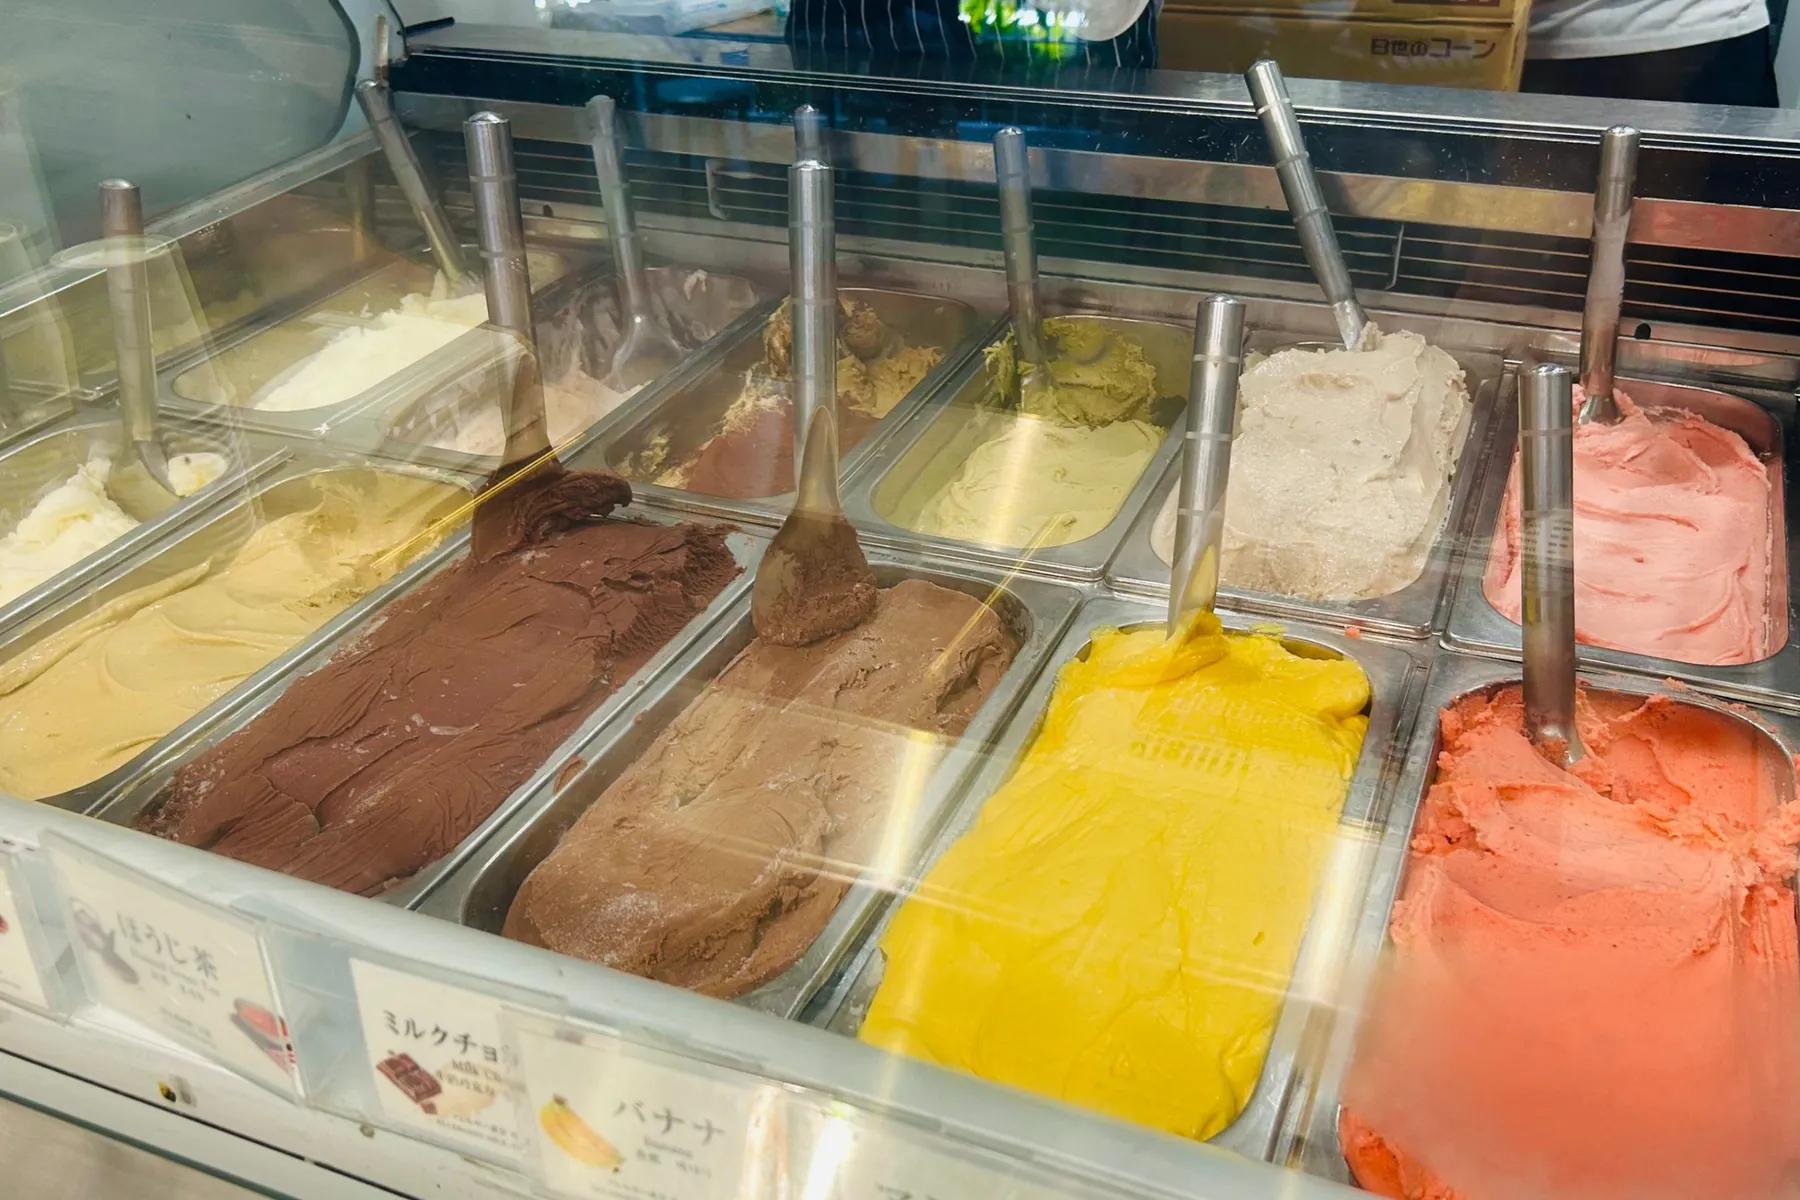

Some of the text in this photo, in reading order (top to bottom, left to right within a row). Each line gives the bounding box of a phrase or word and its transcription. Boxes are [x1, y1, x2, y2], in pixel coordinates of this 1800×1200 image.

[1371, 37, 1496, 58] 日世のコーン
[116, 911, 218, 981] ほうじ茶
[613, 1100, 725, 1146] バナナ
